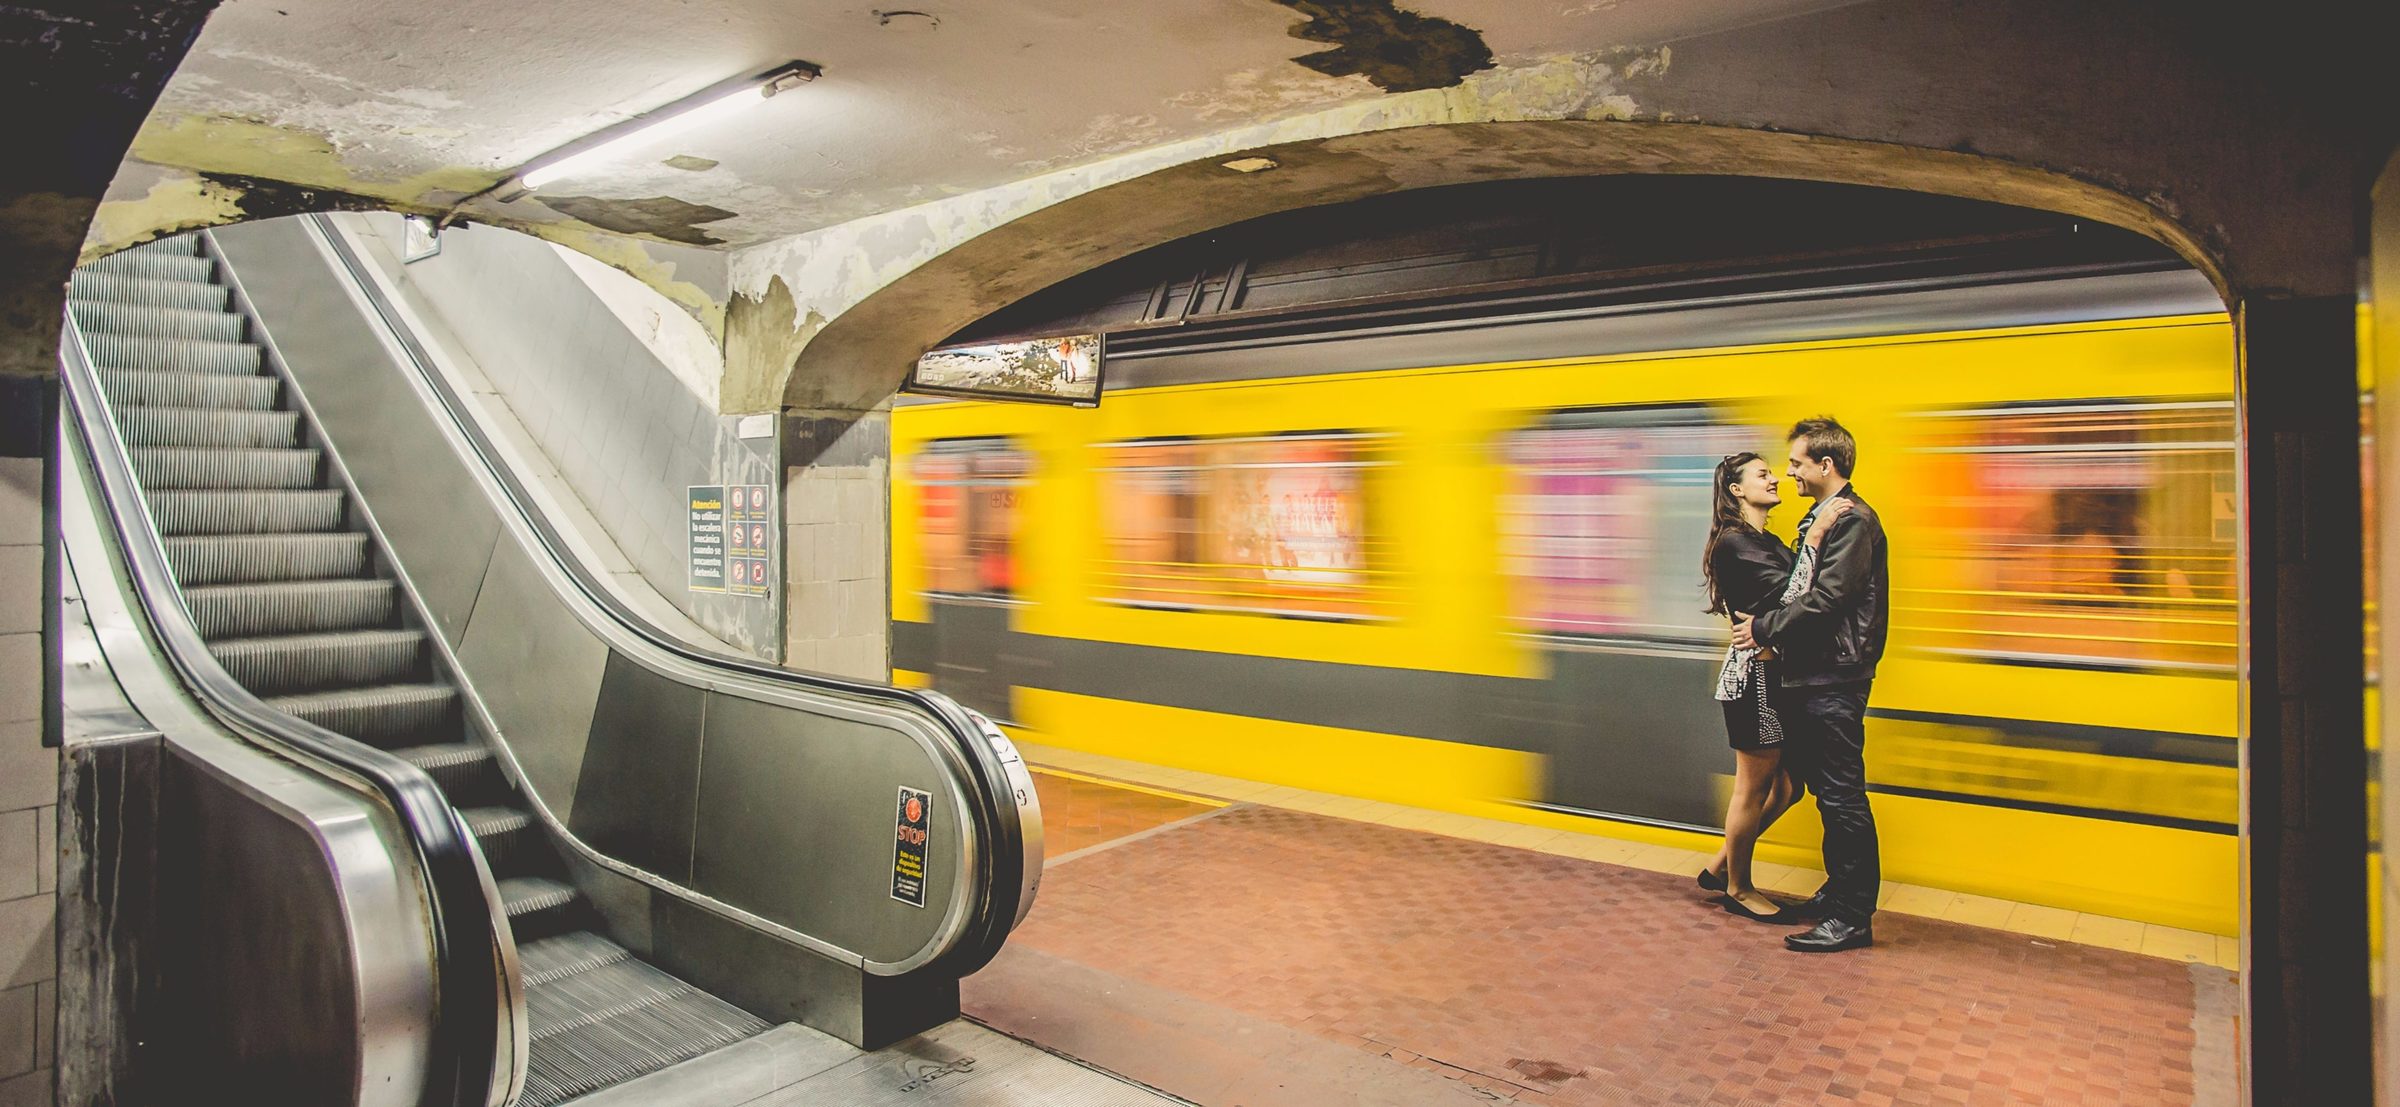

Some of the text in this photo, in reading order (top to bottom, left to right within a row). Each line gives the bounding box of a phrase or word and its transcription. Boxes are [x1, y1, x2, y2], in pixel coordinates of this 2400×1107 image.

[692, 500, 721, 510] Atención
[692, 511, 701, 520] No
[701, 511, 721, 520] utilizar
[692, 523, 721, 532] la escalera
[694, 534, 720, 543] mecánica
[693, 545, 714, 555] cuando
[714, 547, 721, 555] se
[898, 824, 926, 846] STOP
